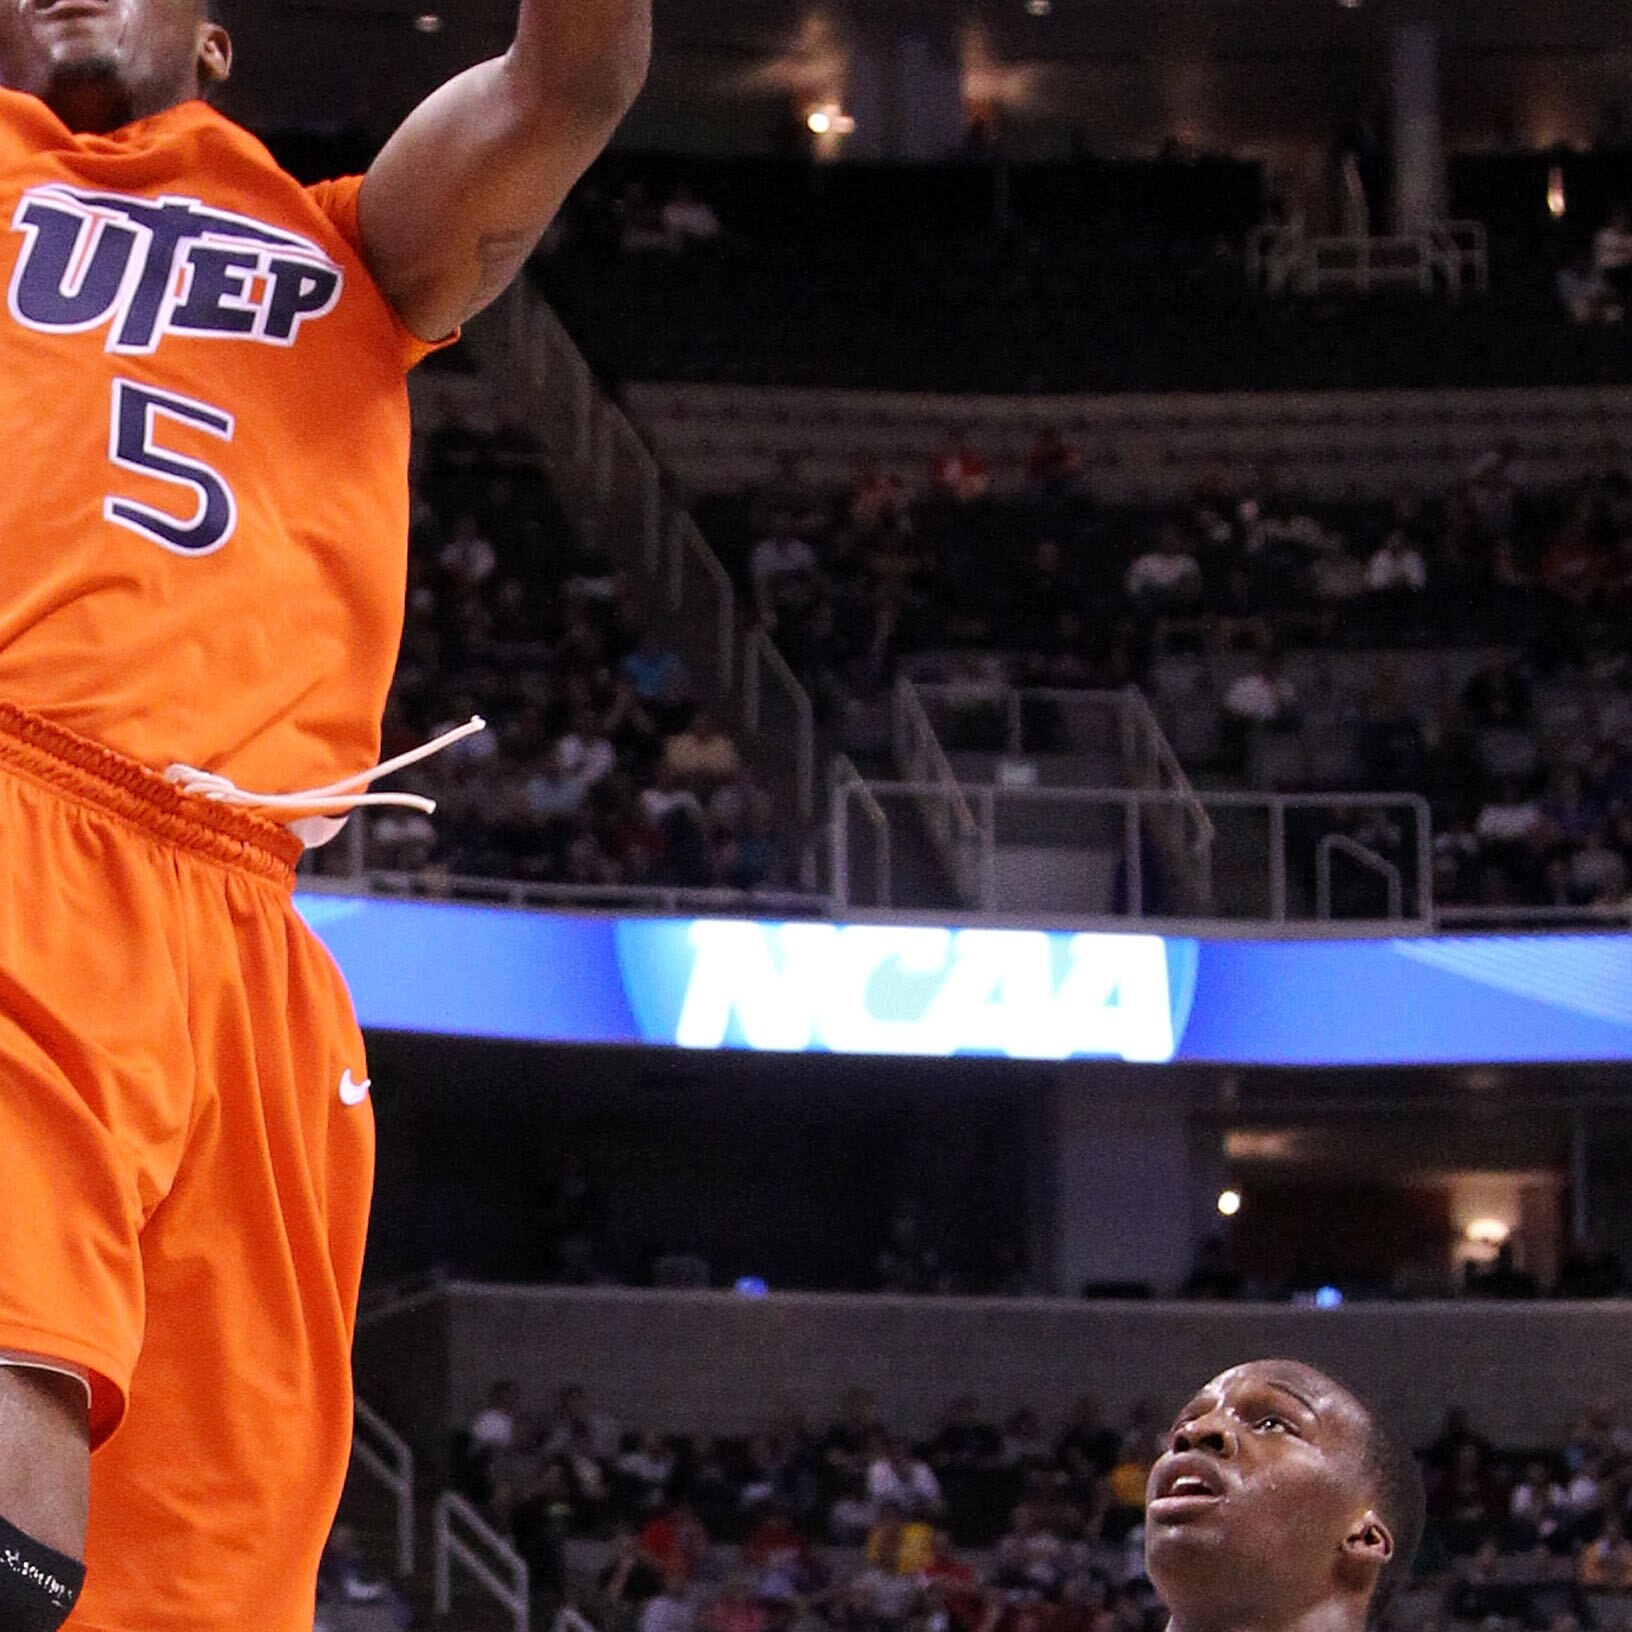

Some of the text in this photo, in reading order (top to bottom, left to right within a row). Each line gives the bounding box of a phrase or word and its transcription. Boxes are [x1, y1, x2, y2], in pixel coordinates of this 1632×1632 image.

[7, 182, 346, 355] UTEP
[103, 375, 237, 558] 5
[676, 919, 1174, 1063] NCAA
